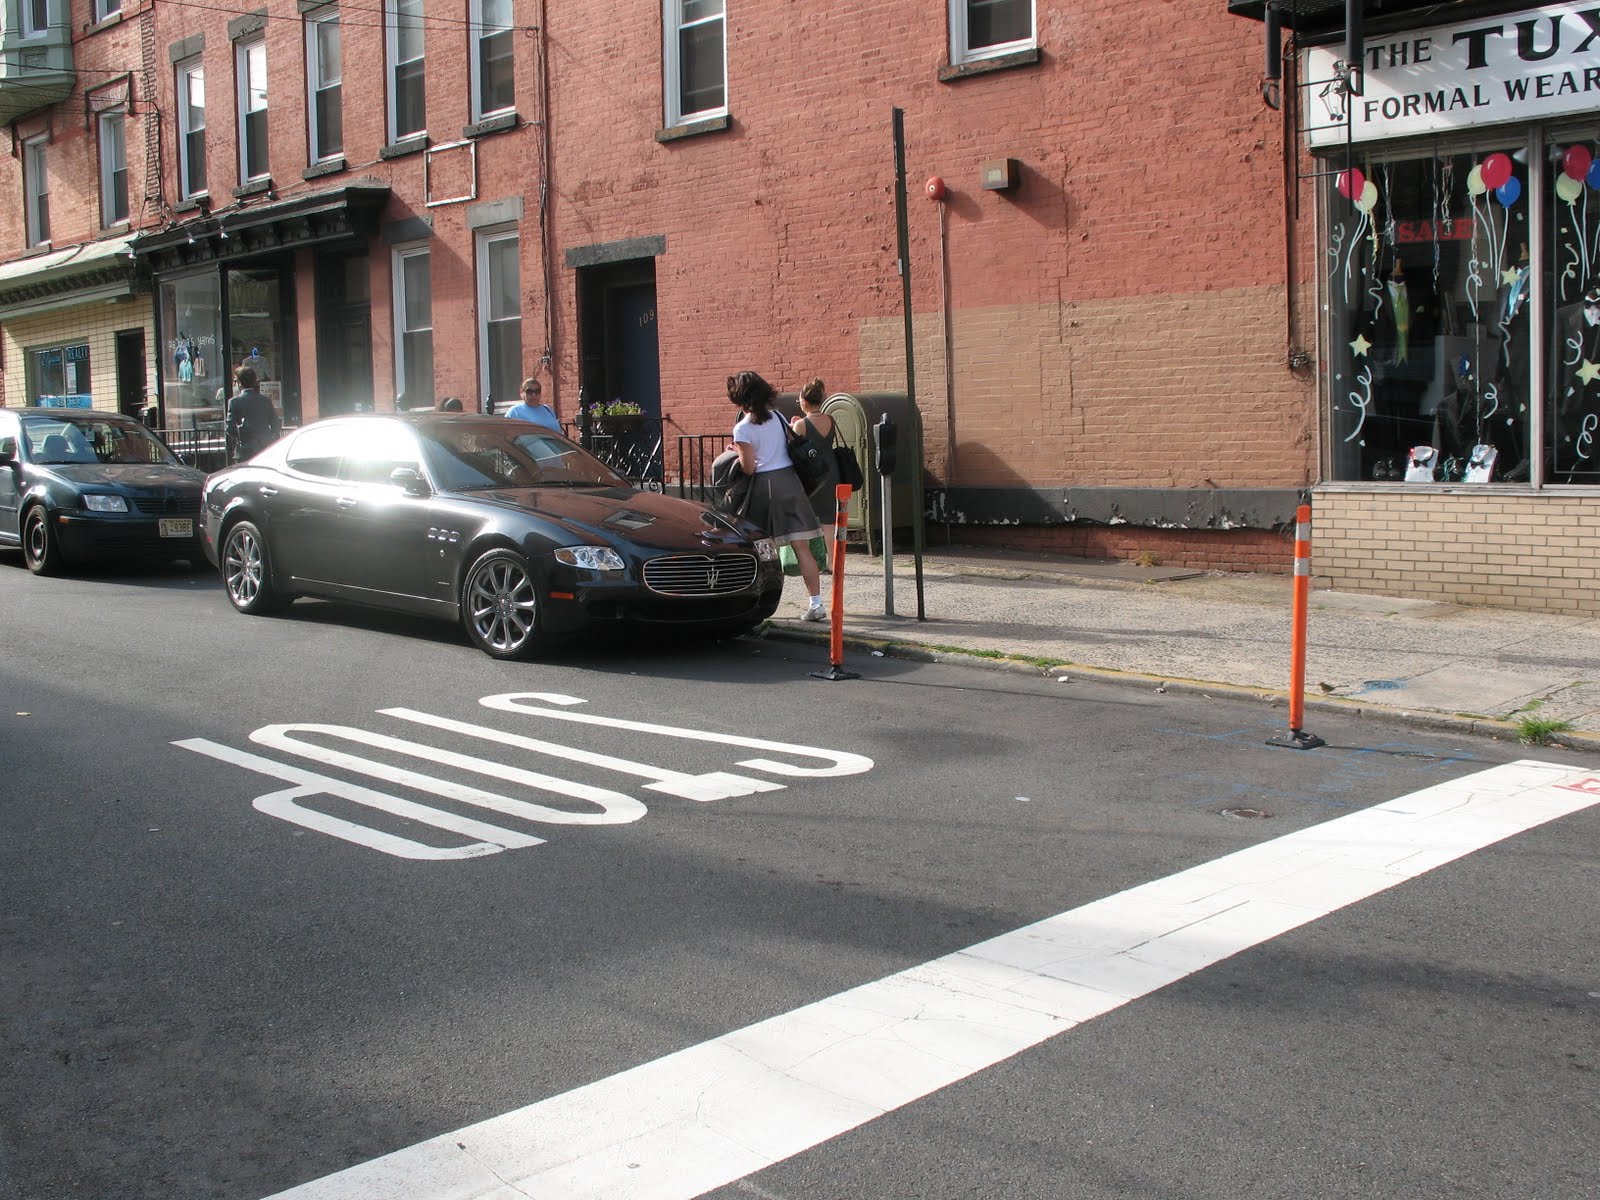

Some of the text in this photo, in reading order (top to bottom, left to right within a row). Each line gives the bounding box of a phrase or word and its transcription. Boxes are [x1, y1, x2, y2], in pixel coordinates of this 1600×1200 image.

[1366, 37, 1432, 70] THE
[1364, 67, 1600, 122] FORMAL WEAR
[1398, 218, 1474, 243] SALE
[639, 309, 655, 328] 109
[169, 692, 876, 861] STOP
